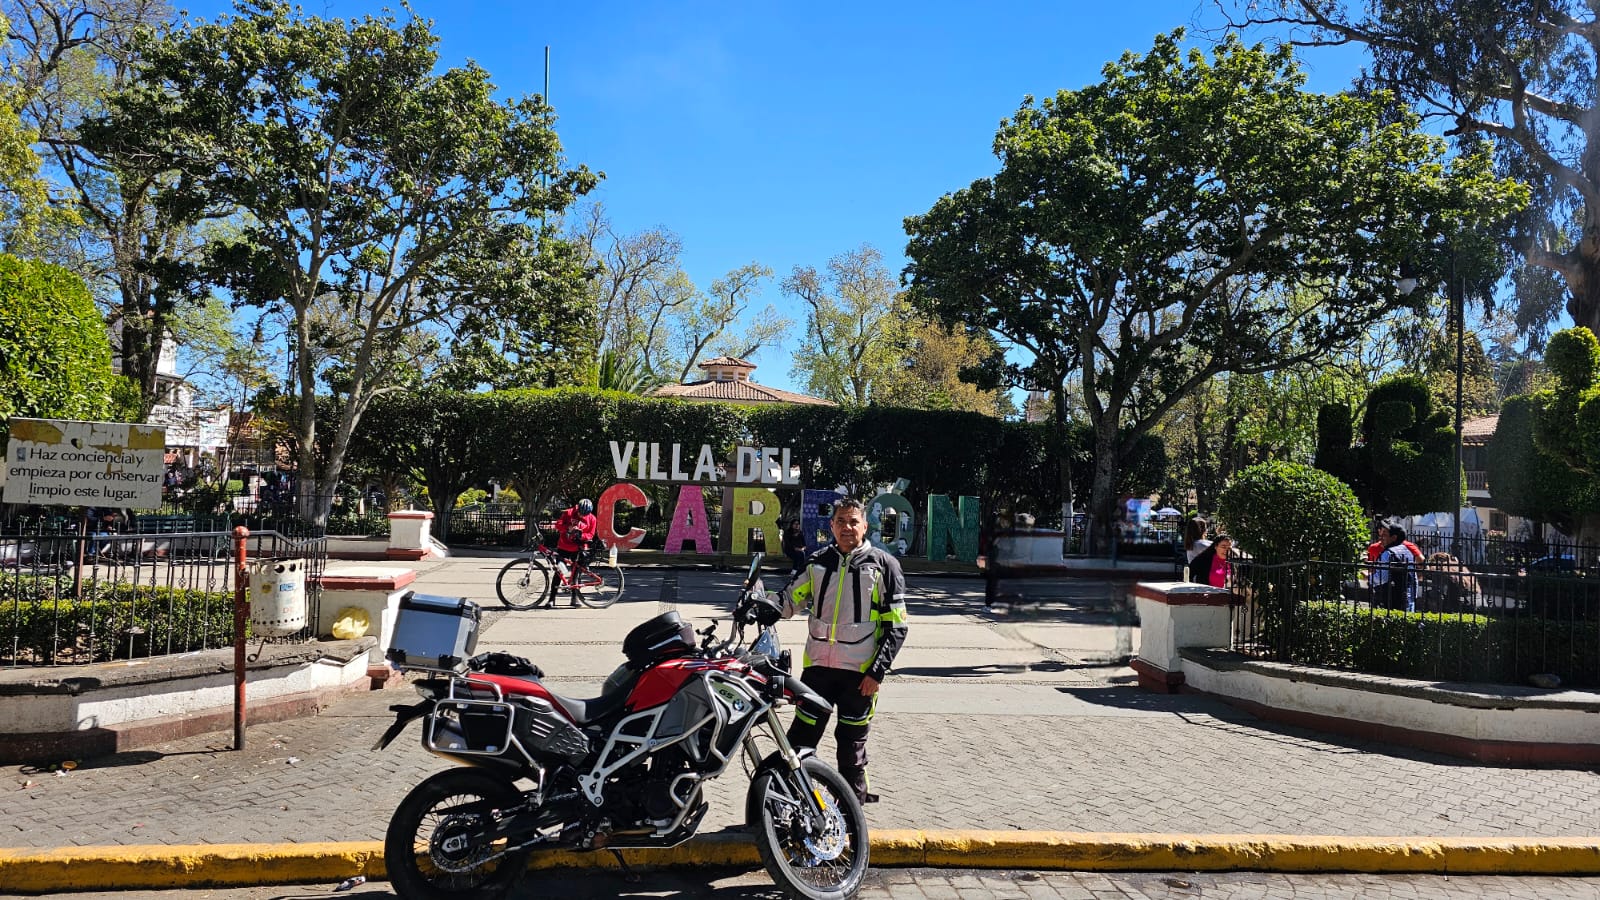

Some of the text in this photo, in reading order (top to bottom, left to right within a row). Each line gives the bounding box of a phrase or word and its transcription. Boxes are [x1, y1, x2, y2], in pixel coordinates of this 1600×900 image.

[30, 448, 145, 468] Haz conciencia y
[609, 440, 800, 485] VILLA DEL
[10, 466, 161, 483] empieza por conservar
[29, 482, 138, 502] limpio este lugar.
[719, 688, 735, 700] GS
